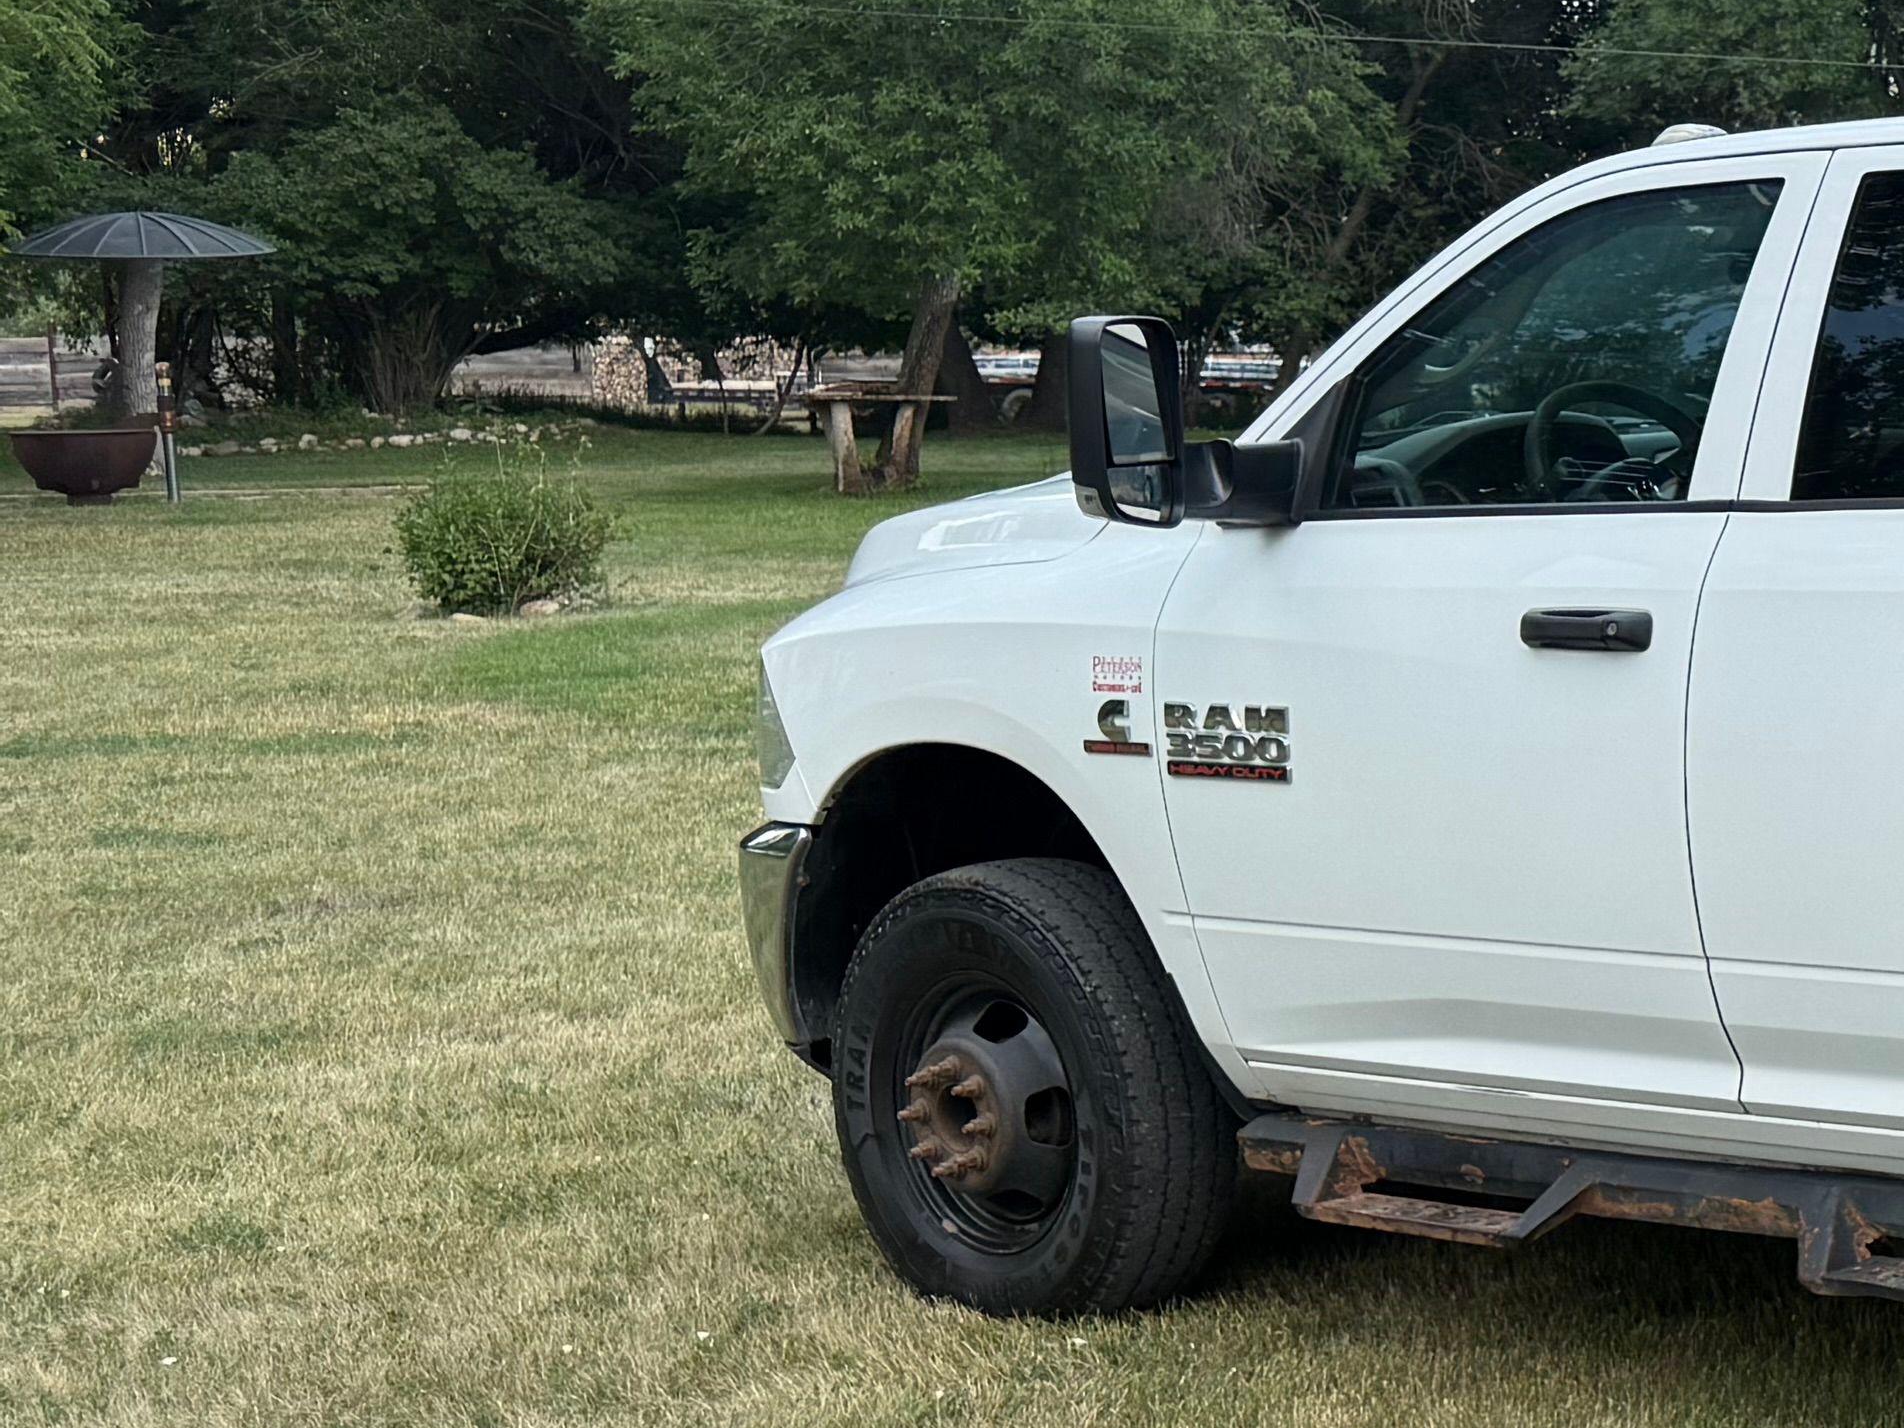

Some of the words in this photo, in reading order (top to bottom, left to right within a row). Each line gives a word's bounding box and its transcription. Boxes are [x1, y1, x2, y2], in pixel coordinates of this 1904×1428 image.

[1163, 700, 1290, 734] RAM
[1165, 730, 1291, 764] 3500
[1170, 763, 1230, 777] HEAVY
[1232, 765, 1286, 780] DUTY
